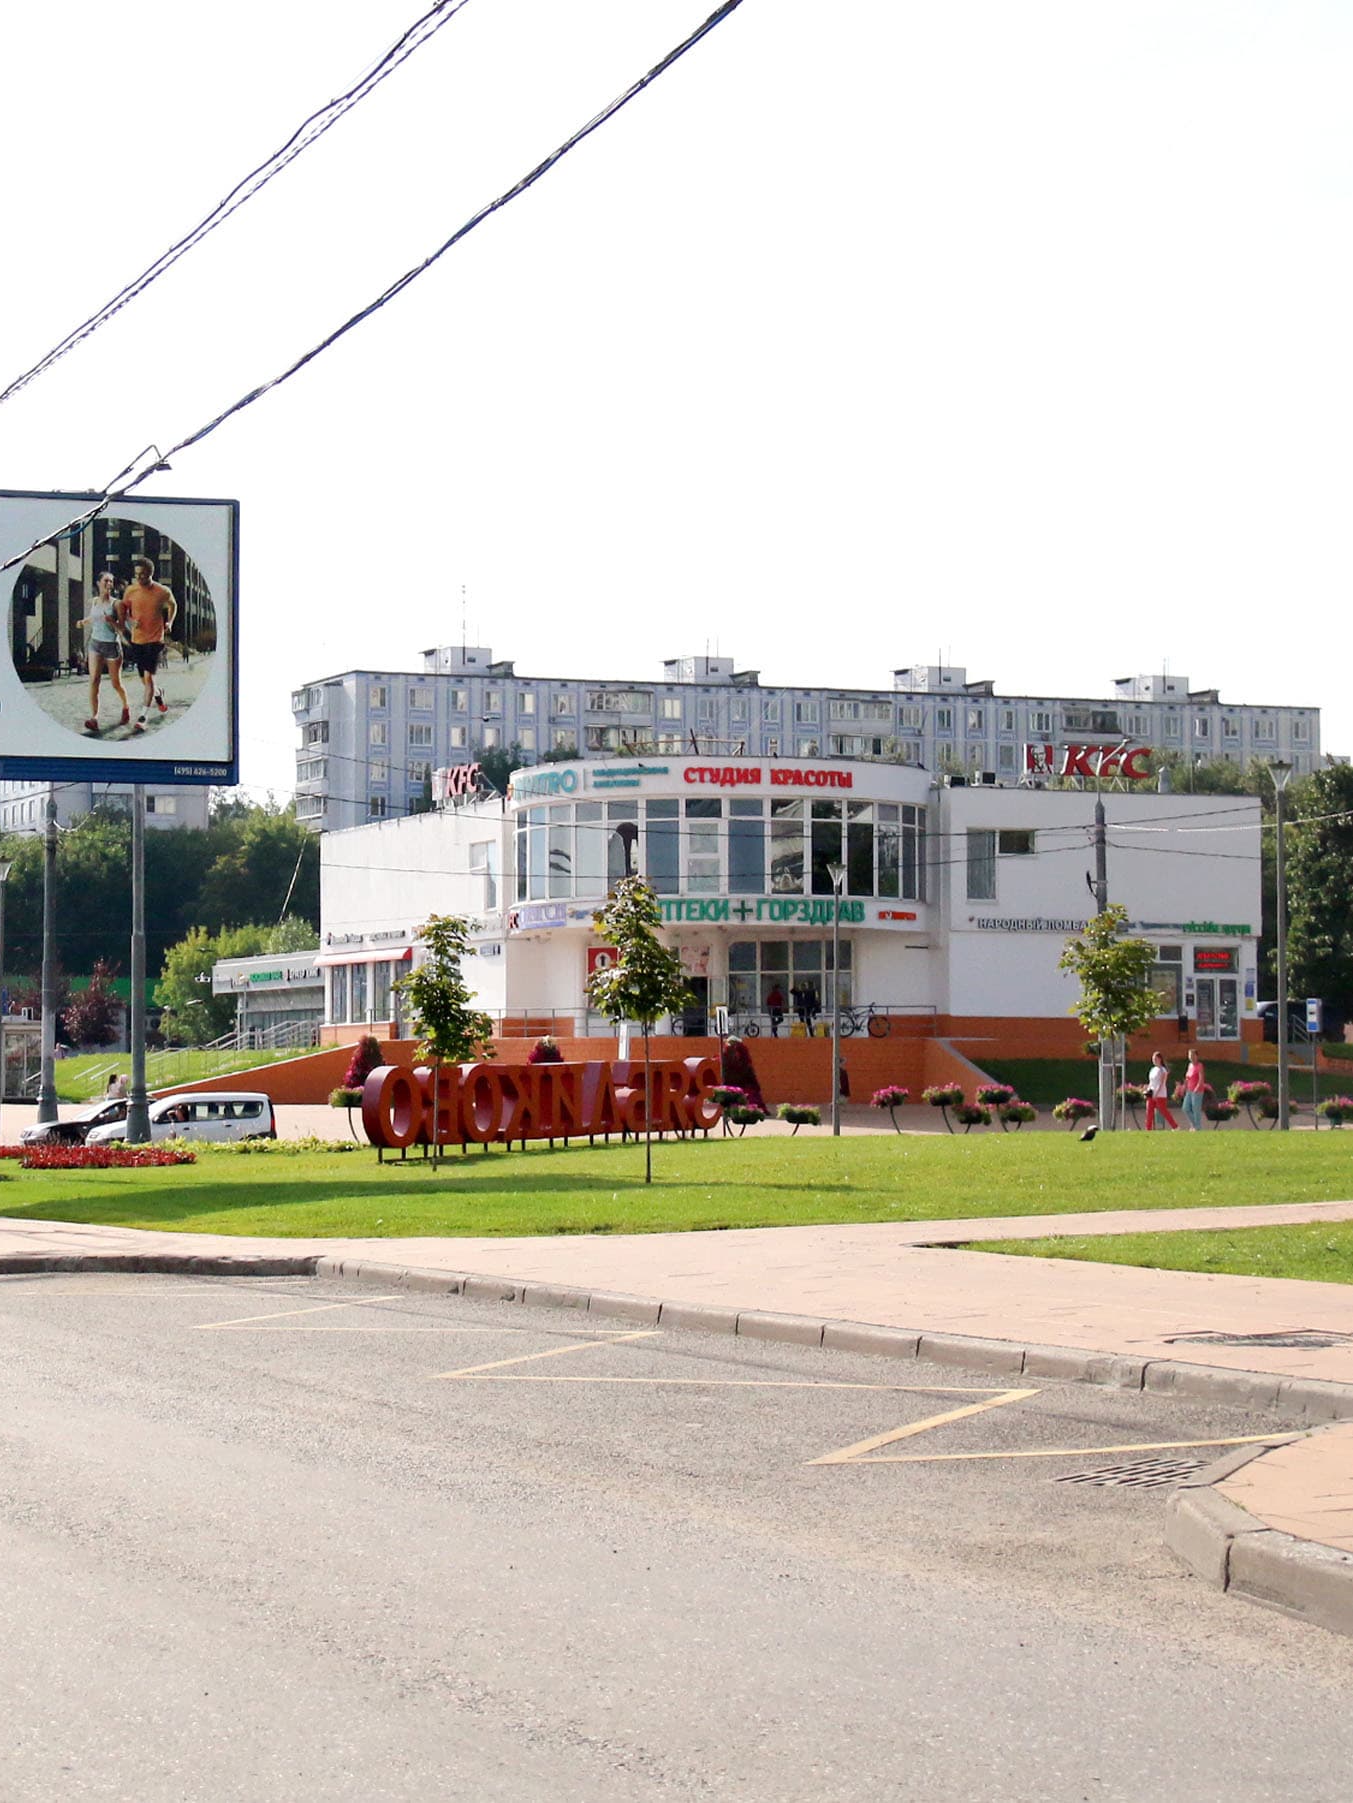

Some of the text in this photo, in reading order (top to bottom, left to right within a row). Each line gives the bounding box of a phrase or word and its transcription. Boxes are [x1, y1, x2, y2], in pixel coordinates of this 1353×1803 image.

[1060, 744, 1153, 779] KFC
[447, 762, 482, 797] KFC
[683, 767, 762, 788] СТУДИЯ
[769, 768, 853, 788] КРАСОТЫ
[653, 899, 729, 922] ПТЕКИ
[977, 917, 1043, 932] НАРОДНЫЙ
